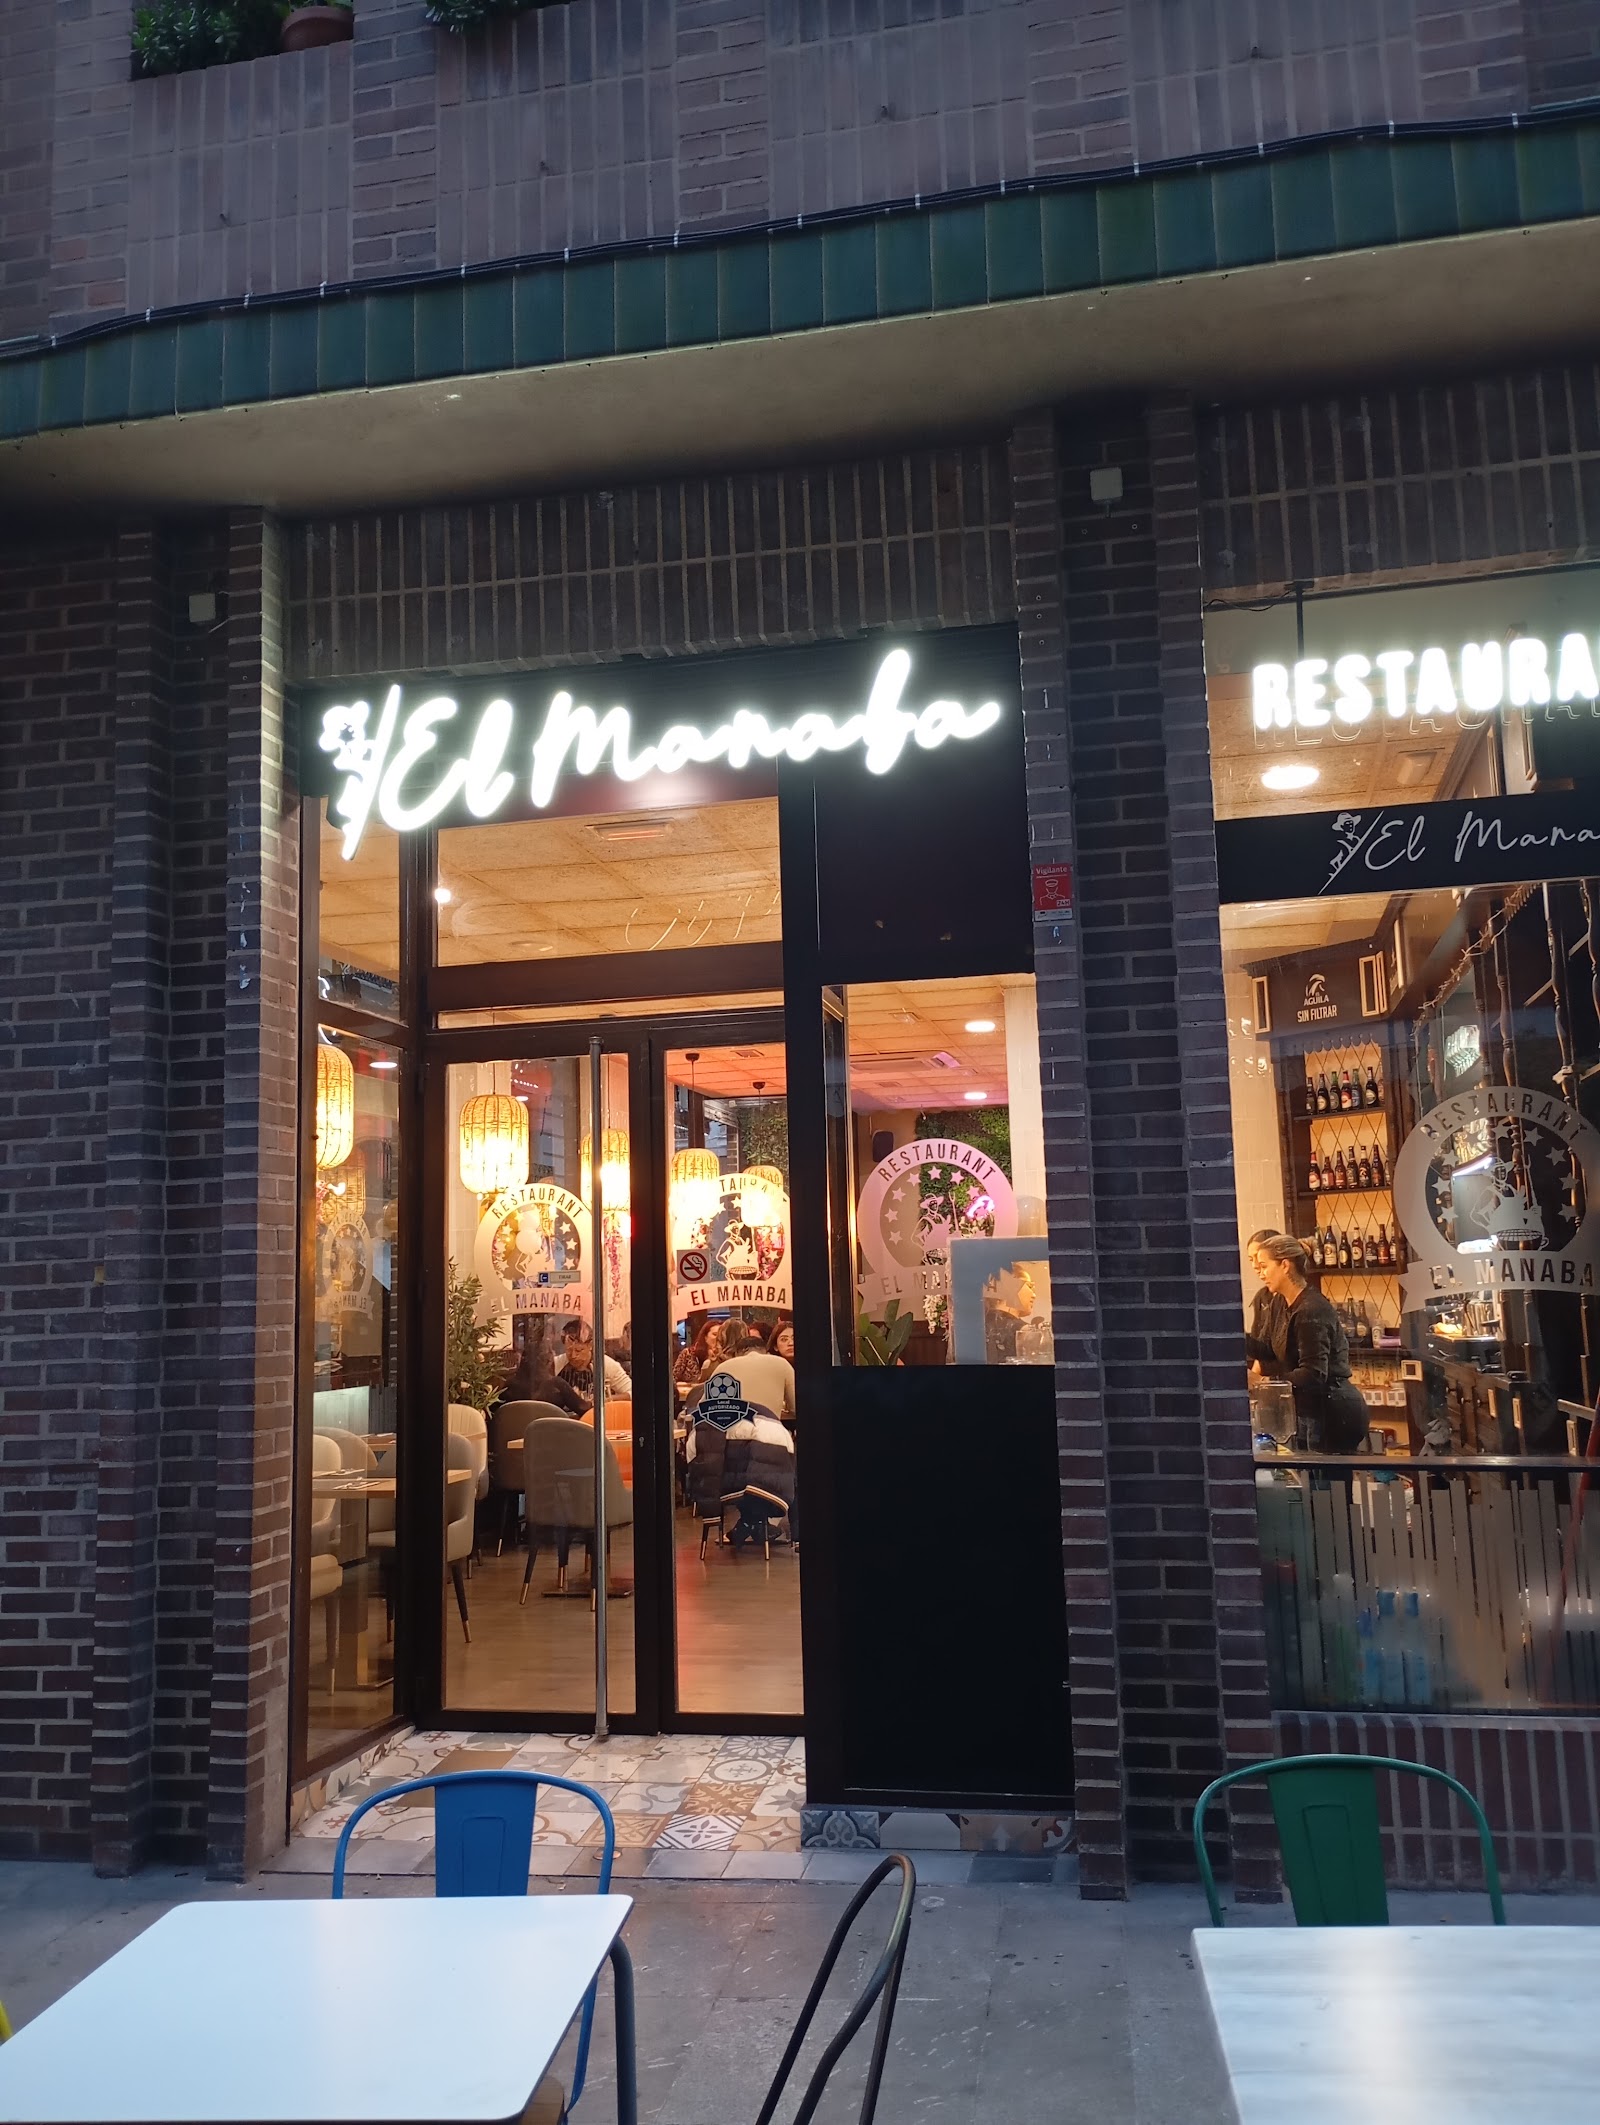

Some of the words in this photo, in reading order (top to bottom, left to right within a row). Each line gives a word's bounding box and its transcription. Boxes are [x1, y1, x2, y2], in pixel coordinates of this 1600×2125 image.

[1252, 633, 1600, 729] RESTAURA
[379, 697, 514, 831] El
[532, 649, 1000, 808] Manaba
[1365, 815, 1425, 870] El
[1036, 866, 1068, 875] Vigilante
[1297, 1009, 1310, 1023] SIN
[1310, 1004, 1338, 1021] FILTRAR
[1420, 1092, 1588, 1141] RESTAURANT
[878, 1143, 996, 1182] RESTAURANT
[492, 1187, 583, 1219] RESTAURANT
[881, 1277, 903, 1296] EL
[1429, 1263, 1463, 1290] EL
[1473, 1257, 1593, 1287] MANABA
[490, 1295, 510, 1313] EL
[516, 1292, 582, 1311] MANABA
[690, 1289, 710, 1306] EL
[717, 1285, 786, 1304] MANABA
